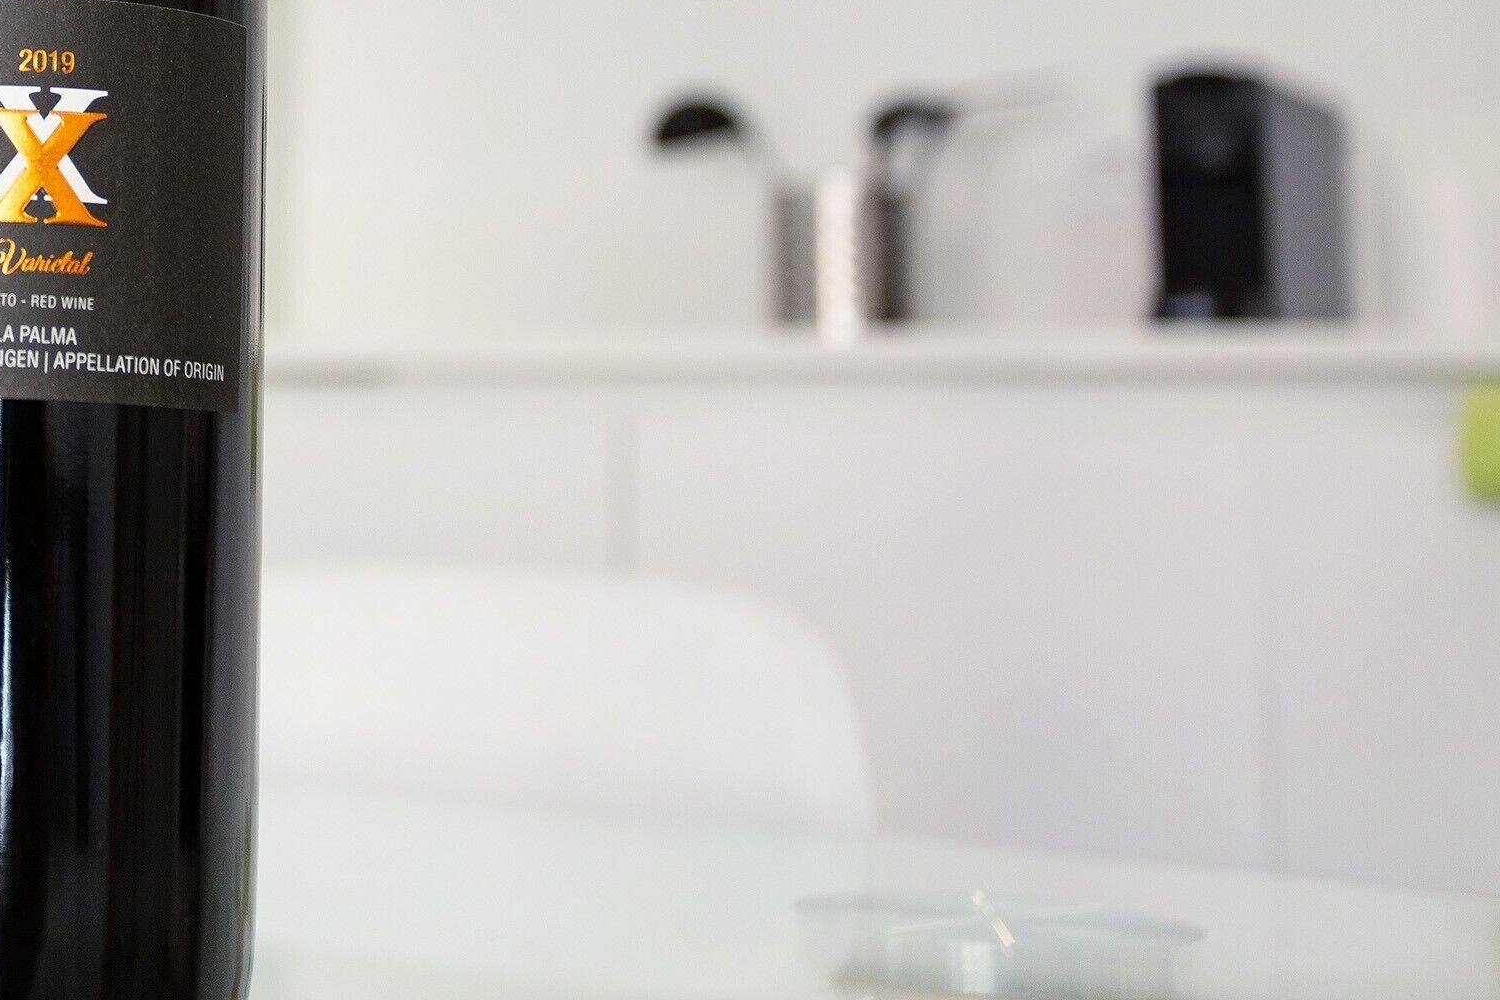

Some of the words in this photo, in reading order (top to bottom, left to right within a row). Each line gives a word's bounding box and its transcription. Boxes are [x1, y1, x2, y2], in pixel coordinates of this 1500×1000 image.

[19, 48, 76, 74] 2019
[30, 294, 57, 309] RED
[60, 296, 95, 311] WINE
[19, 325, 78, 346] PALMA
[52, 351, 160, 376] APPELLATION
[163, 358, 181, 377] OF
[184, 361, 225, 382] ORIGIN
